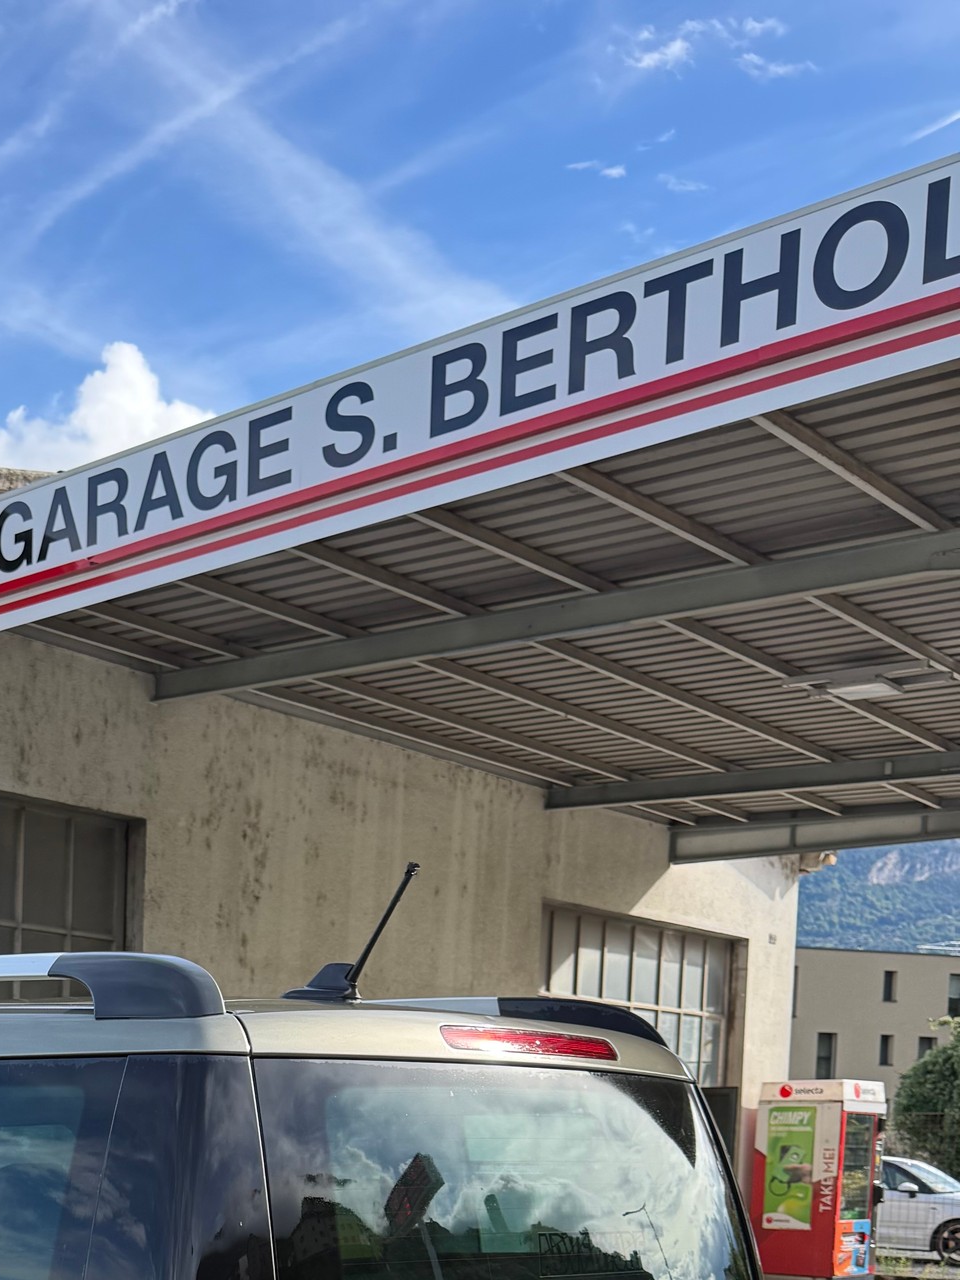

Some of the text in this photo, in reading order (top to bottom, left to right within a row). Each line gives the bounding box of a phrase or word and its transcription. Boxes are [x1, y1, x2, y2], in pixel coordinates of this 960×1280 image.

[322, 381, 398, 468] S.
[430, 176, 960, 438] BERTHOL
[794, 1087, 824, 1095] selecta
[769, 1111, 812, 1125] CHIMPY
[819, 1148, 836, 1213] TAKE ME!
